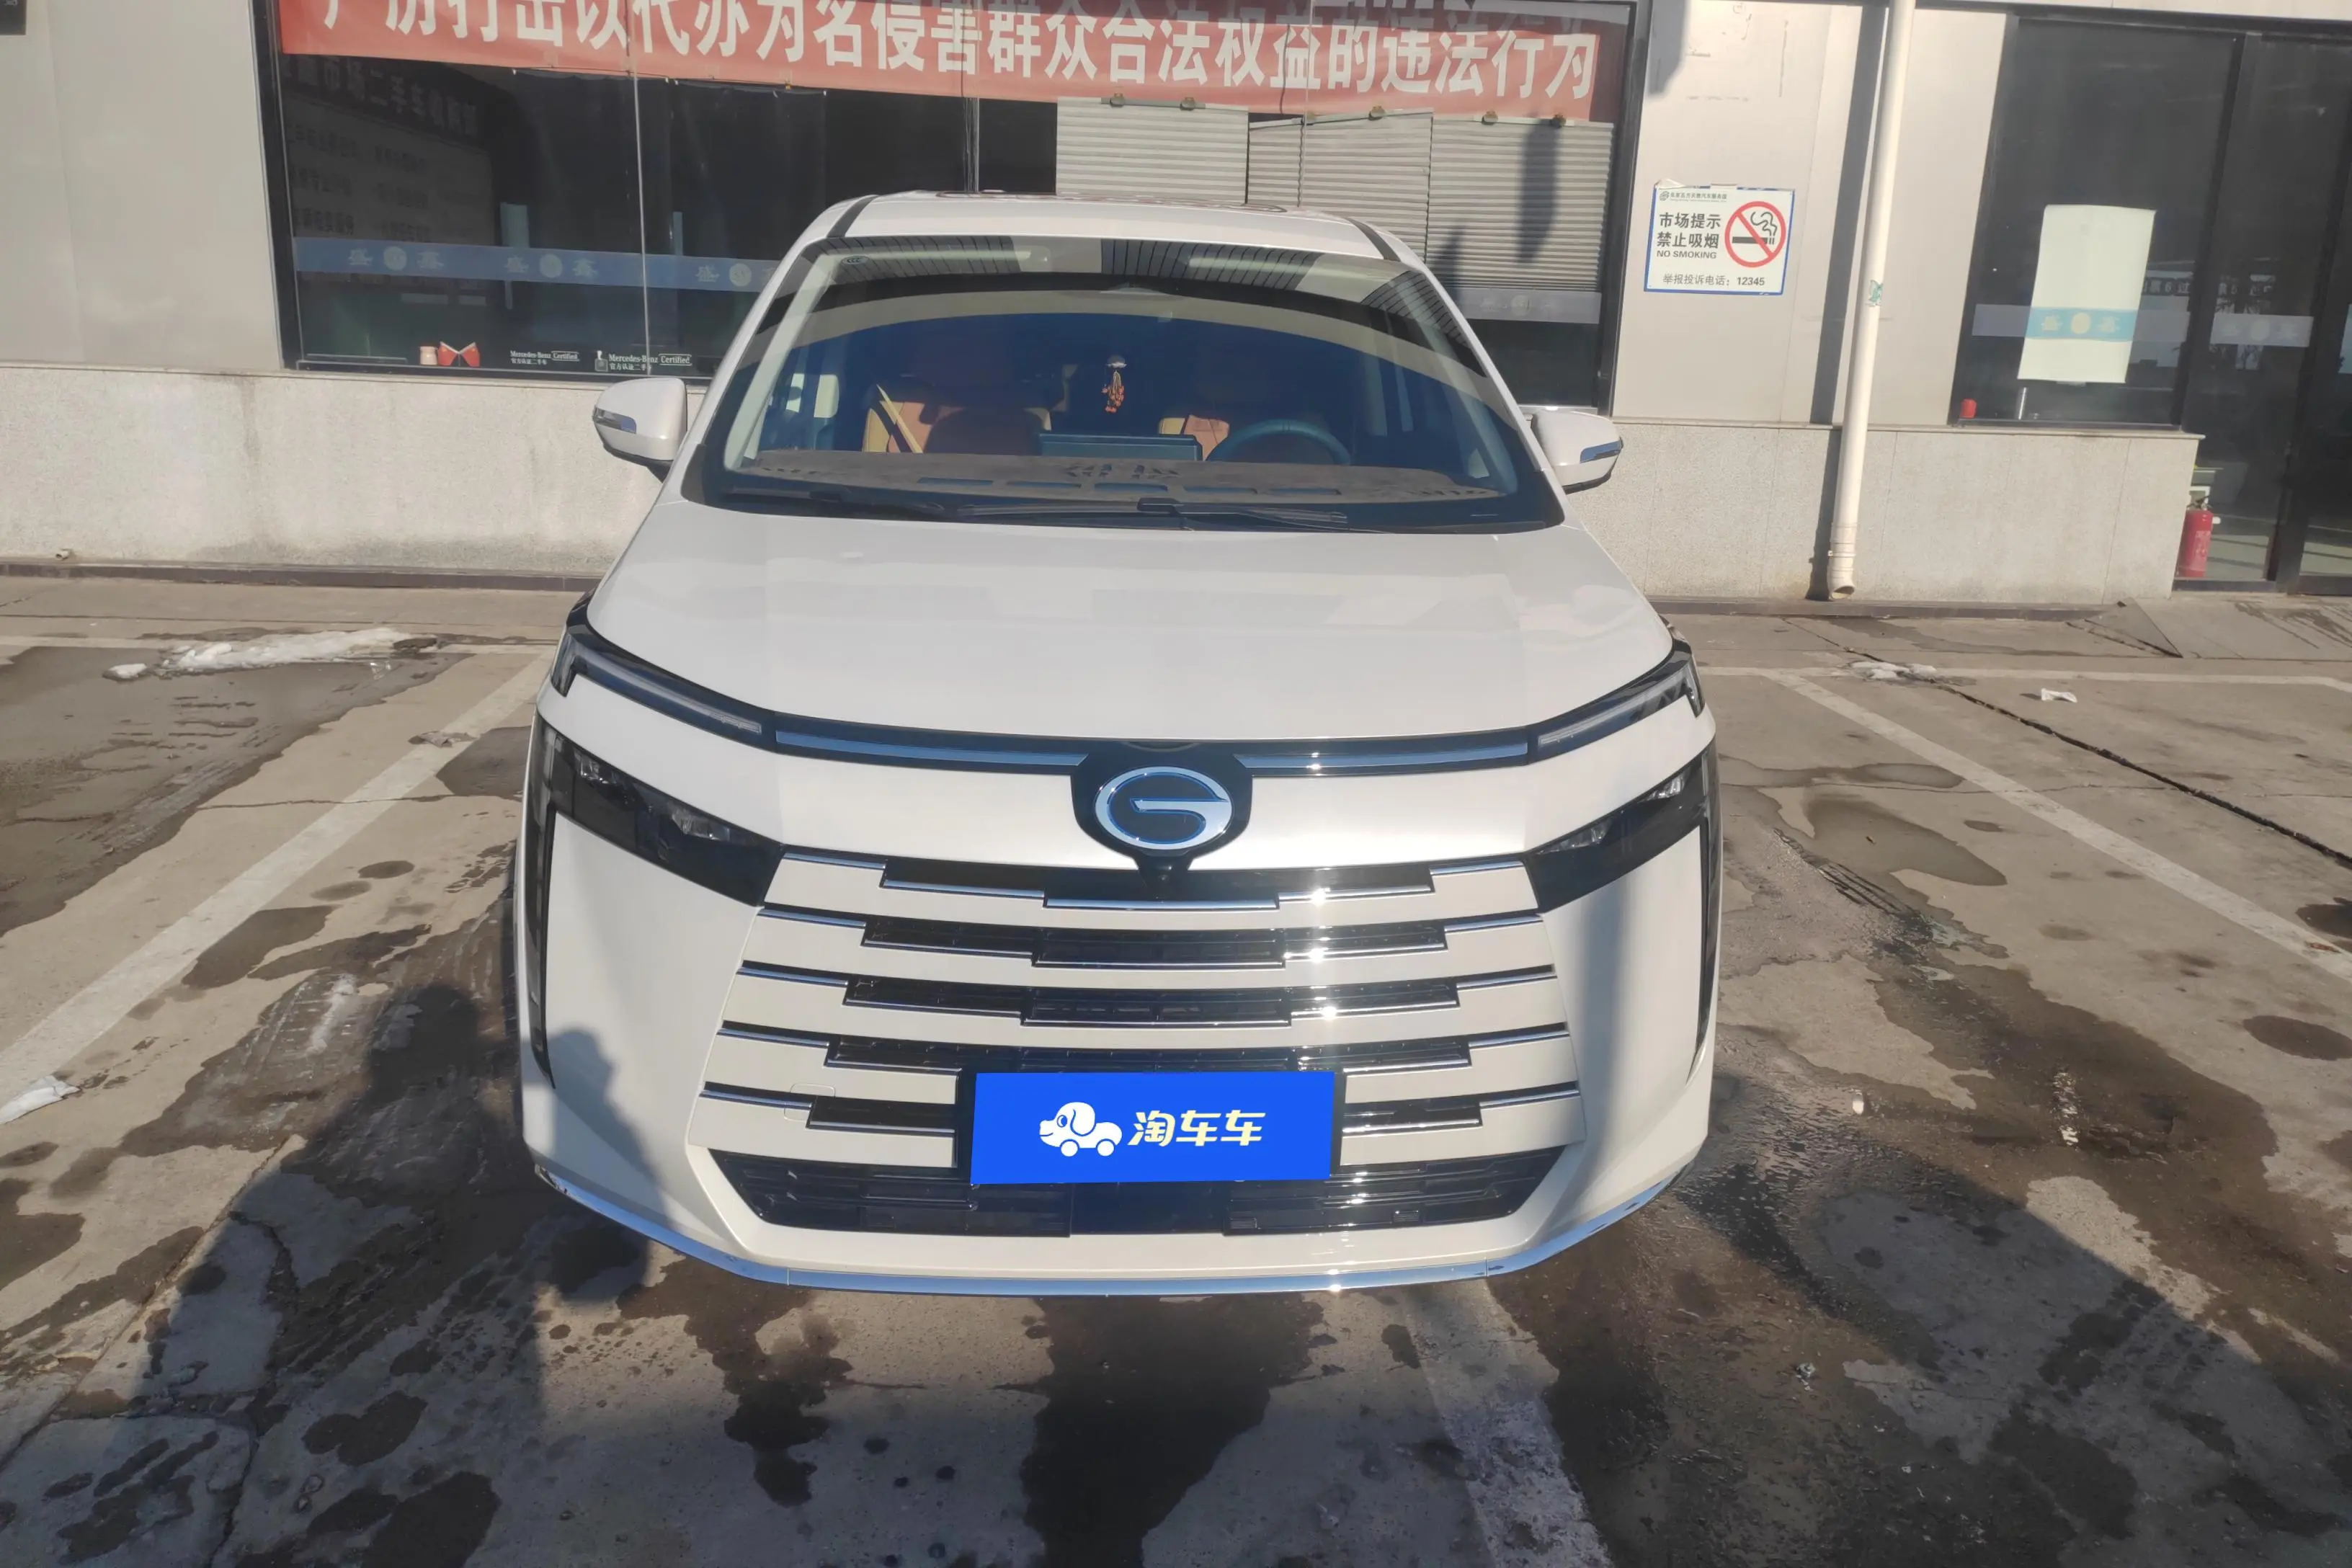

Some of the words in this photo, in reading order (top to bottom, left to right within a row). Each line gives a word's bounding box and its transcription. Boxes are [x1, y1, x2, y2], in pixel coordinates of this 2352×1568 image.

[324, 0, 1594, 99] 打击以代办为名侵害群众合法权益的违法行为
[1660, 213, 1721, 229] 市场提示
[1657, 231, 1720, 249] 禁止吸烟
[1673, 251, 1717, 259] SMOKING
[1737, 277, 1765, 285] 12345
[510, 350, 551, 359] Mercedes-Benz
[553, 352, 579, 360] Certified
[608, 353, 658, 363] Mercedes-Bnz
[661, 355, 690, 364] Certified
